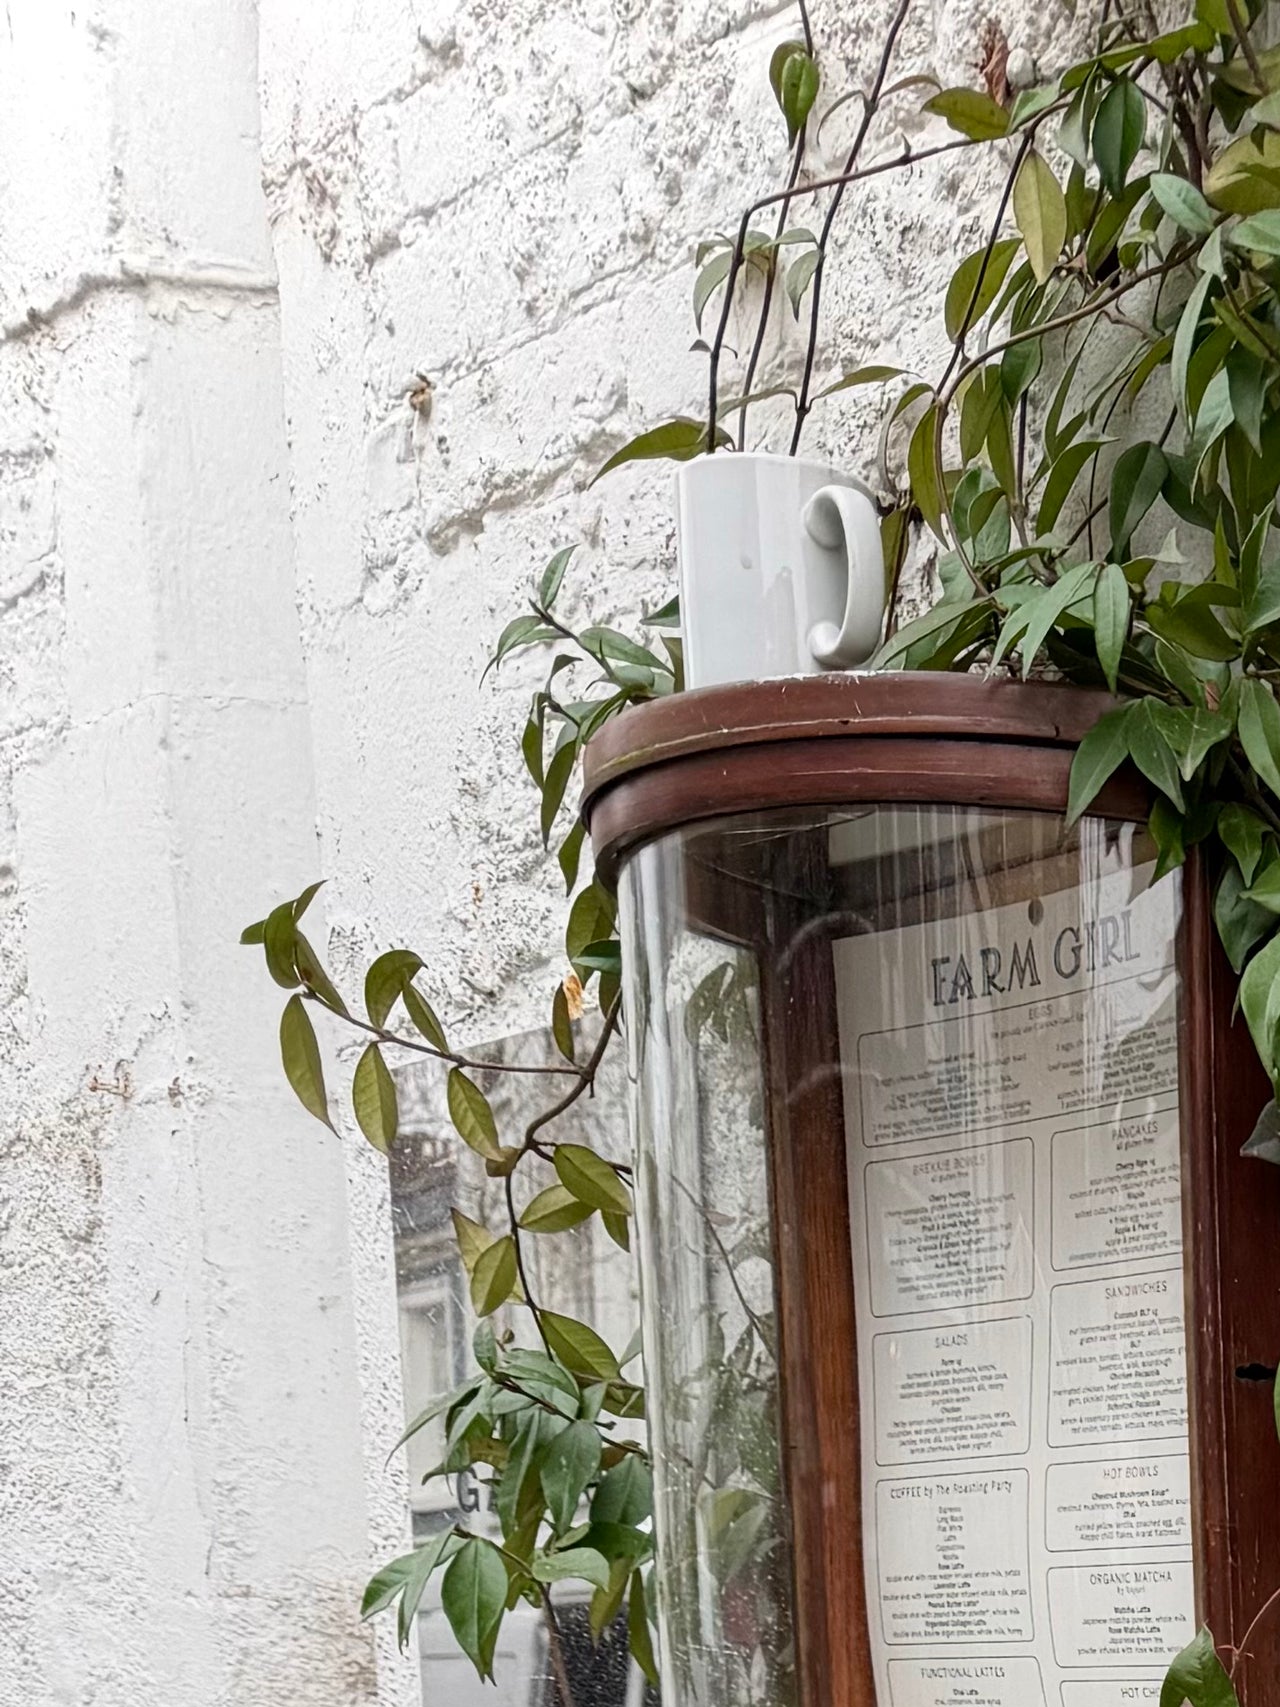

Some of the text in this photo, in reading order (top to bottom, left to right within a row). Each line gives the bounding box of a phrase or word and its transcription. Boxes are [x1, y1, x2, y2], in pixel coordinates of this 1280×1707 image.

[931, 910, 1141, 1007] FARM GIRL
[1112, 1121, 1159, 1141] PANCAKES
[1105, 1280, 1168, 1300] SANDWICHES
[935, 1333, 969, 1349] SALADS
[1103, 1465, 1159, 1480] HOT BOWLS
[890, 1486, 922, 1499] COFFEE
[924, 1485, 933, 1499] by
[936, 1483, 951, 1496] The
[953, 1481, 989, 1495] Roasting
[1089, 1570, 1173, 1586] ORGANIC MATCHA
[920, 1666, 1006, 1679] FUNCTIONAL LATTES
[1121, 1687, 1139, 1699] HOT
